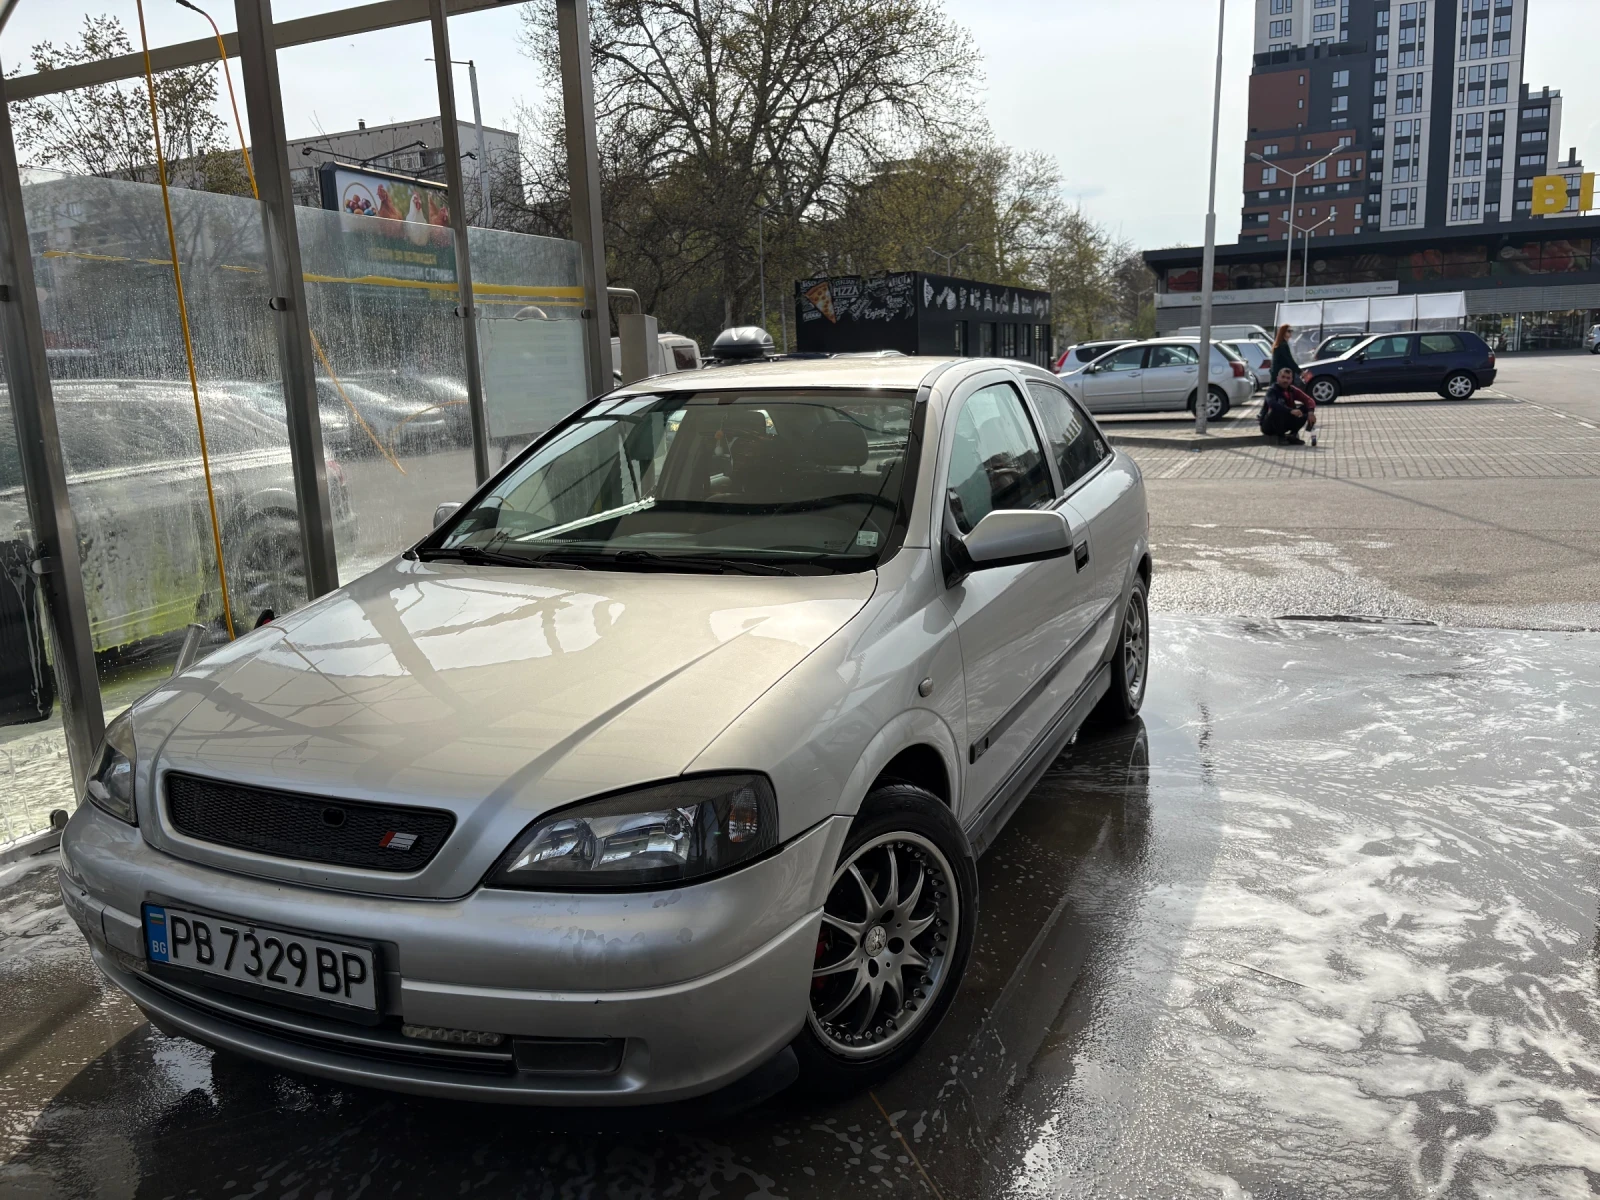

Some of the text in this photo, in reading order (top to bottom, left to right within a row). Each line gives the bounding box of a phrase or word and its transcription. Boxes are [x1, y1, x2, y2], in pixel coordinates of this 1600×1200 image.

[1531, 172, 1595, 215] BI
[833, 286, 860, 297] PIZZA
[152, 940, 167, 955] BG
